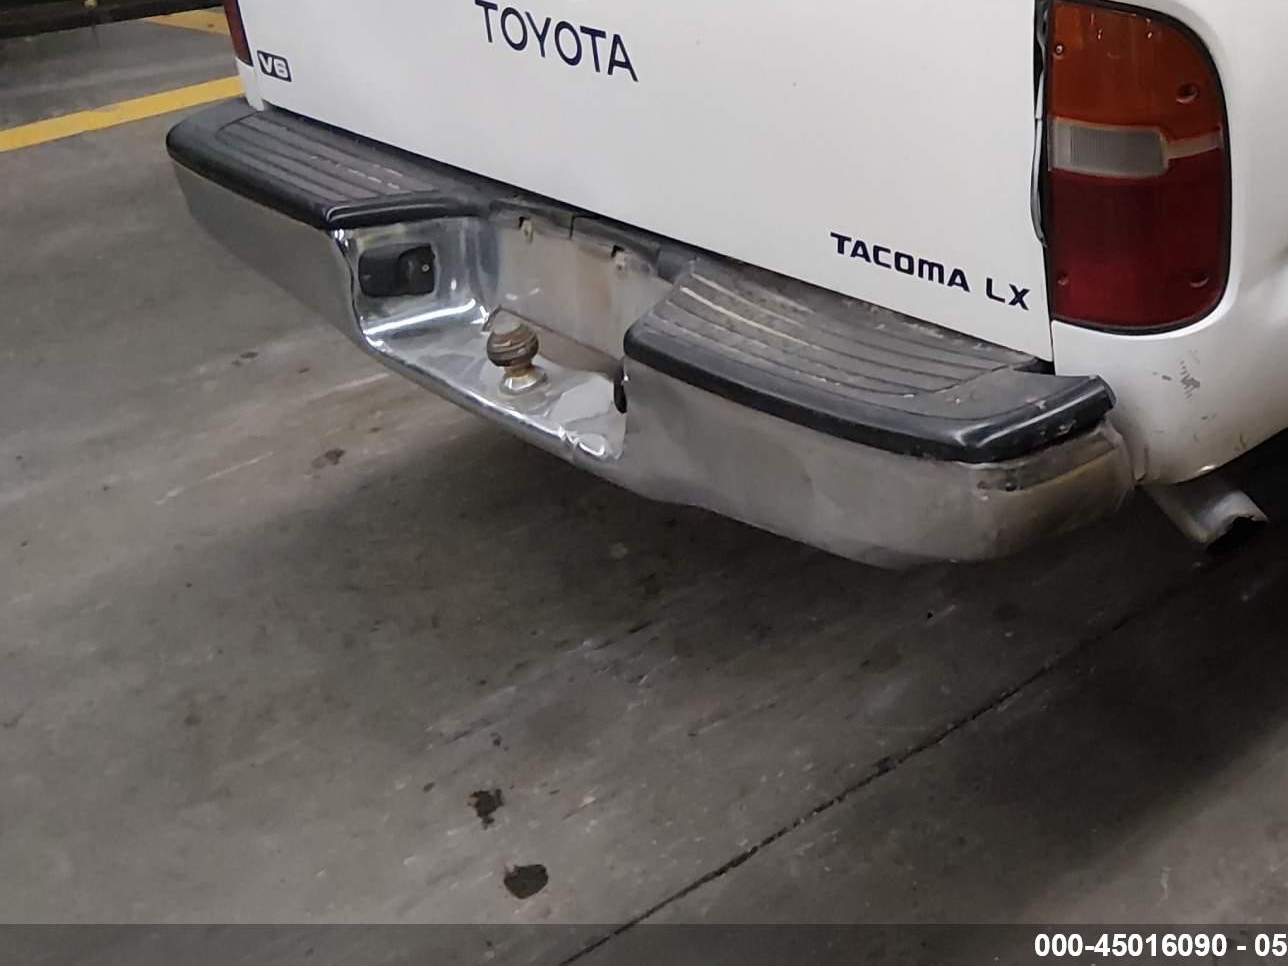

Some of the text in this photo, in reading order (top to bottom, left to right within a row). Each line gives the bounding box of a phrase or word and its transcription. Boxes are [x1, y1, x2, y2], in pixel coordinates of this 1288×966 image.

[258, 51, 290, 80] V6
[830, 231, 1030, 311] TACOMA LX
